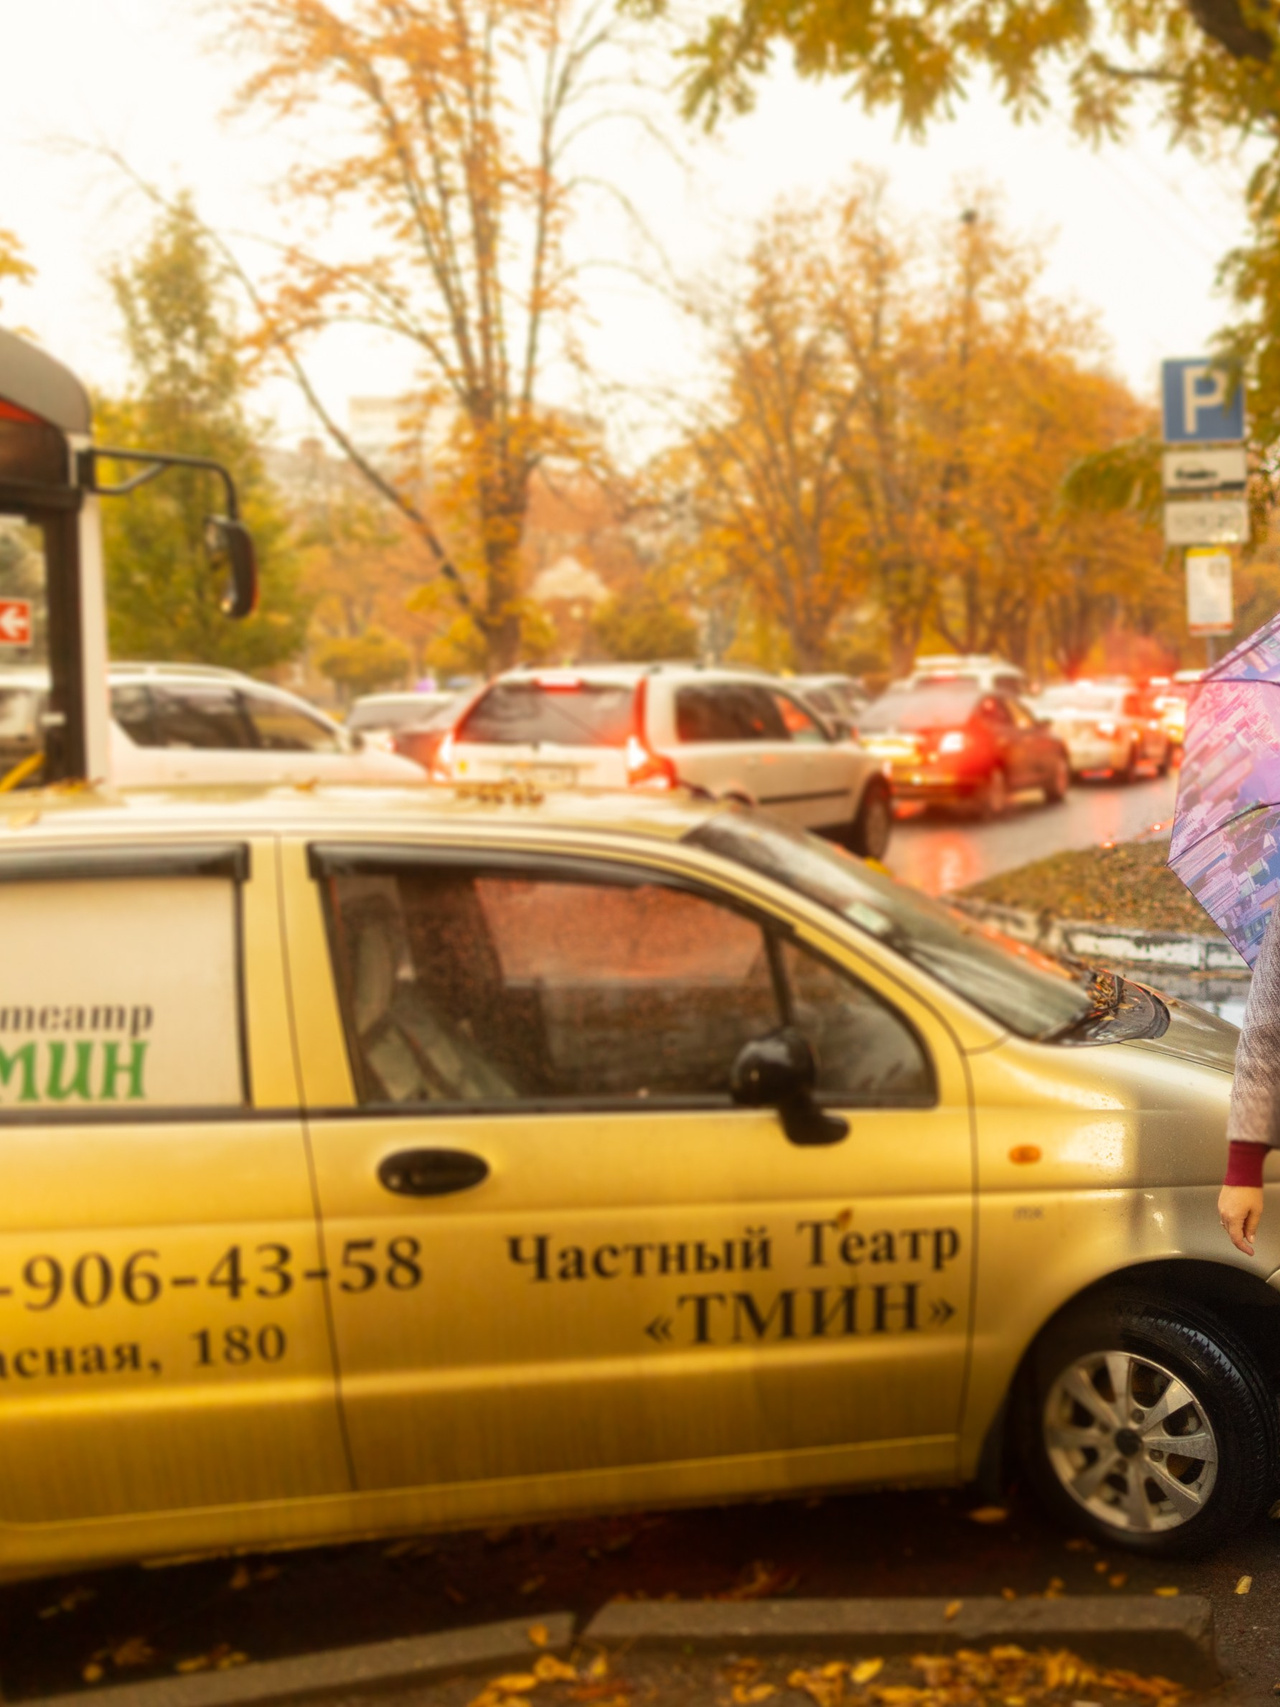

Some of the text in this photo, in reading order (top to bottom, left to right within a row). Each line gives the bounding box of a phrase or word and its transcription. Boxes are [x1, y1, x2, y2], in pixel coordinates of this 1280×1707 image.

[1183, 364, 1230, 435] P
[506, 1218, 961, 1283] Частный Театр
[644, 1281, 957, 1345] «ТМИН»
[0, 1323, 288, 1383] сная, 180
